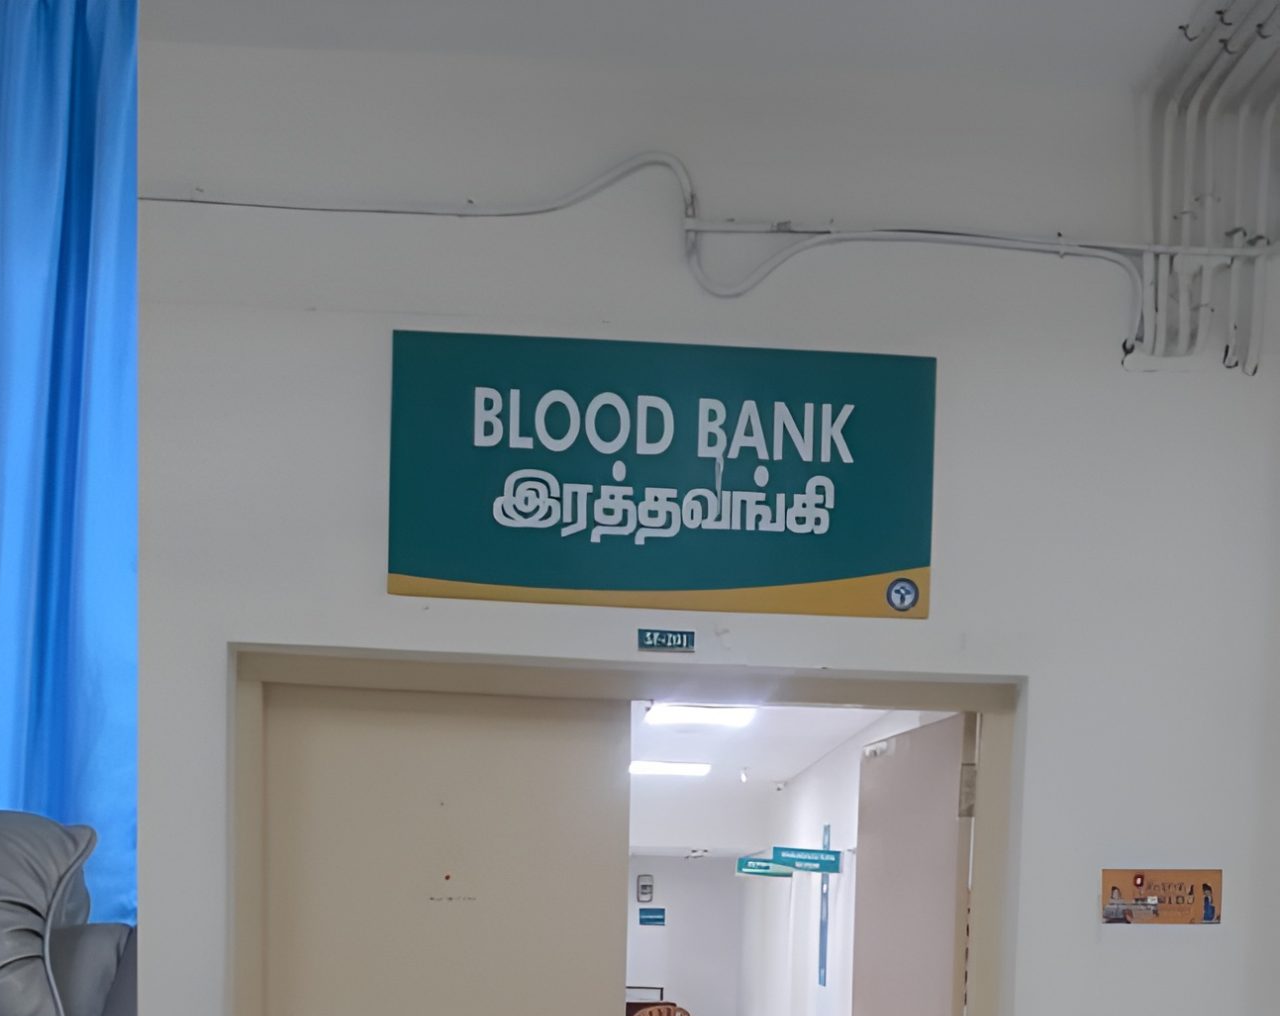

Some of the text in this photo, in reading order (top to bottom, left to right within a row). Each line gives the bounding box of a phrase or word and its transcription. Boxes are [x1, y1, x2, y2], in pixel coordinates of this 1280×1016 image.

[474, 387, 855, 464] BLOOD BANK
[493, 461, 835, 545] இரத்தவங்கி
